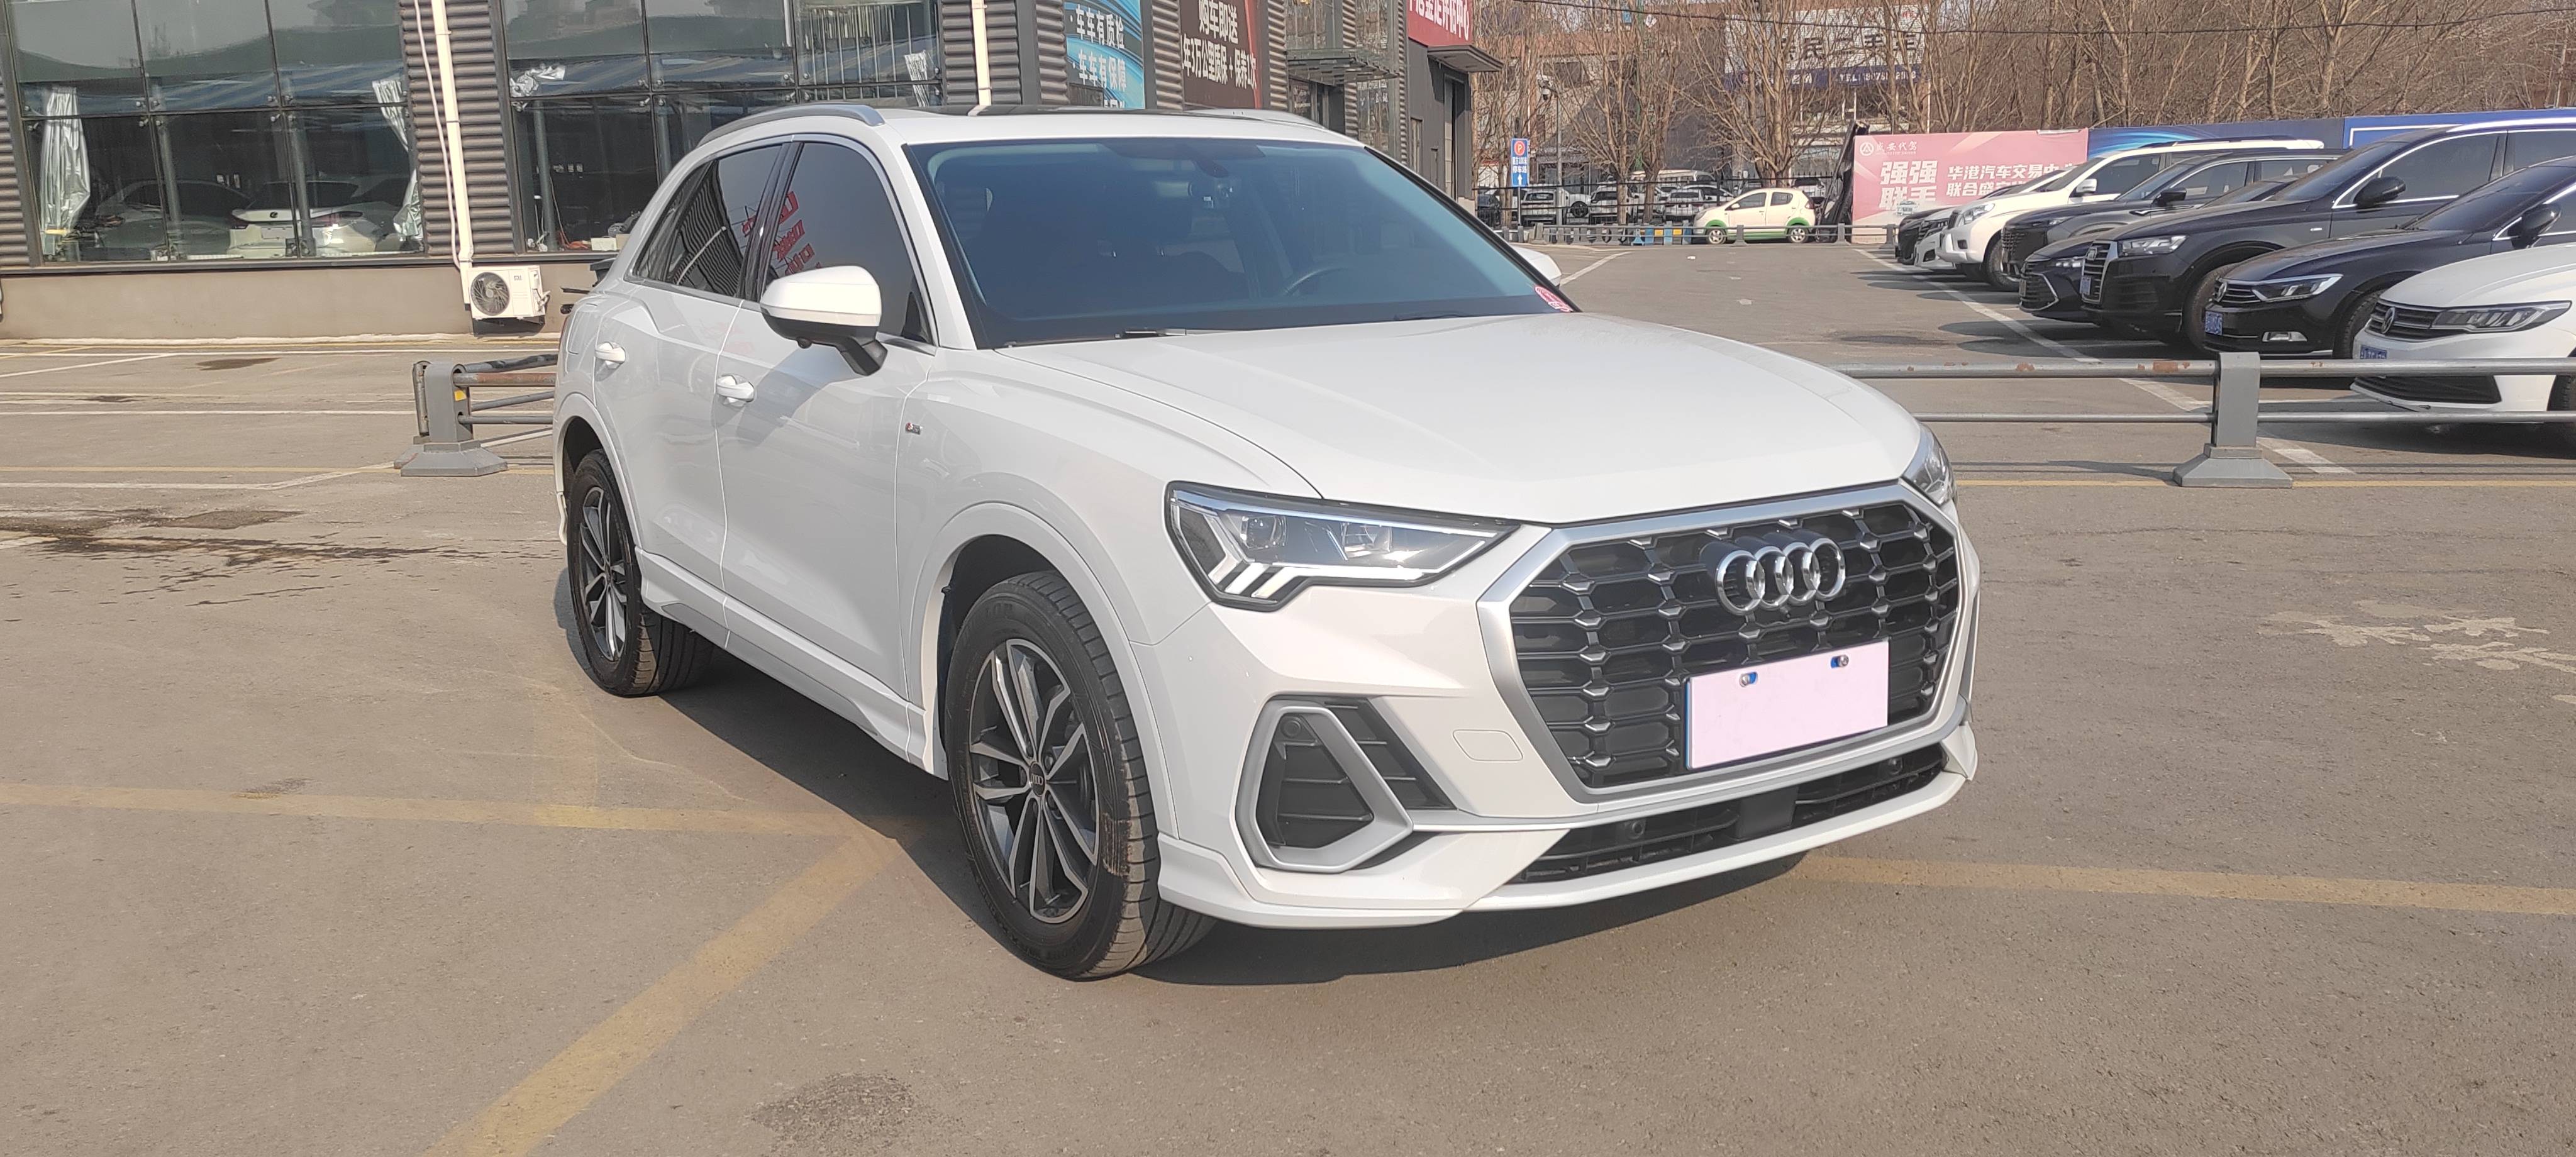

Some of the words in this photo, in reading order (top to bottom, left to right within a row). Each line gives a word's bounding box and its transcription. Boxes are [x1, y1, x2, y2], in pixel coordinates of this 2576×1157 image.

[1076, 4, 1124, 49] 车车有质检
[1199, 0, 1238, 44] 购车即送
[1079, 48, 1126, 92] 车车有保障
[1880, 160, 1938, 185] 强强
